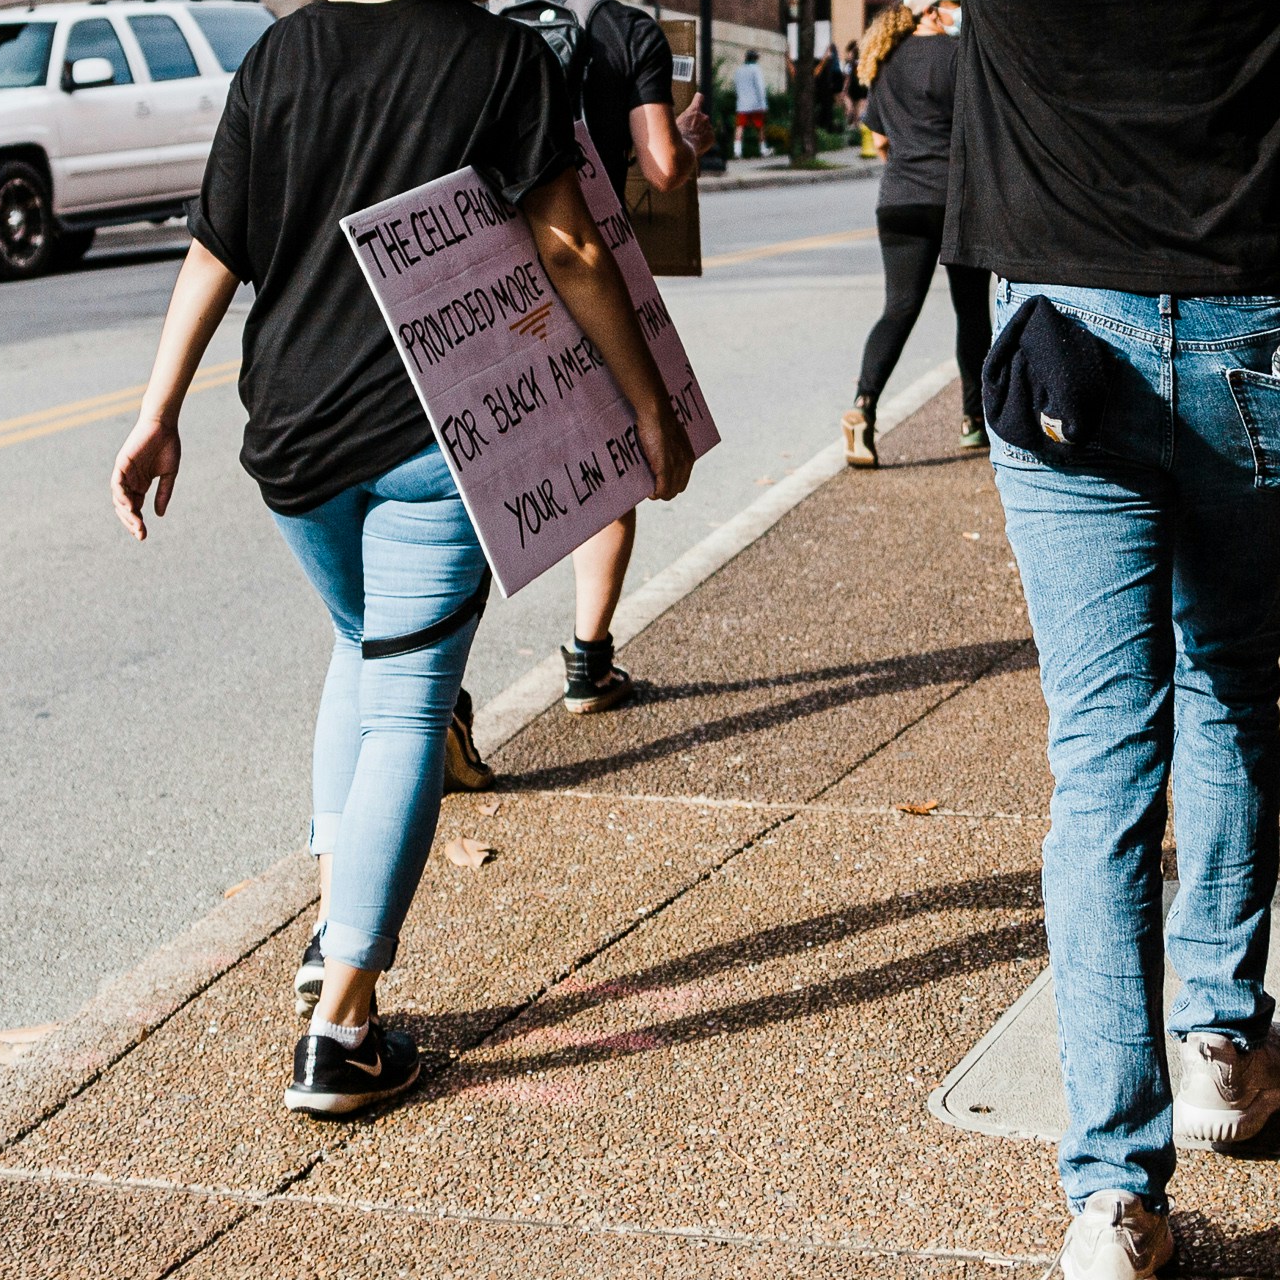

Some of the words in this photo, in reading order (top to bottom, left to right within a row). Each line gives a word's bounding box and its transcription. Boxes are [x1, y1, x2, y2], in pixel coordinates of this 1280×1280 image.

[410, 204, 468, 257] CELL
[399, 288, 496, 374] PROVIDED
[491, 262, 545, 320] MORE
[441, 409, 490, 472] FOR
[483, 366, 548, 434] BLACK
[504, 478, 568, 549] YOUR
[564, 451, 605, 506] LAW
